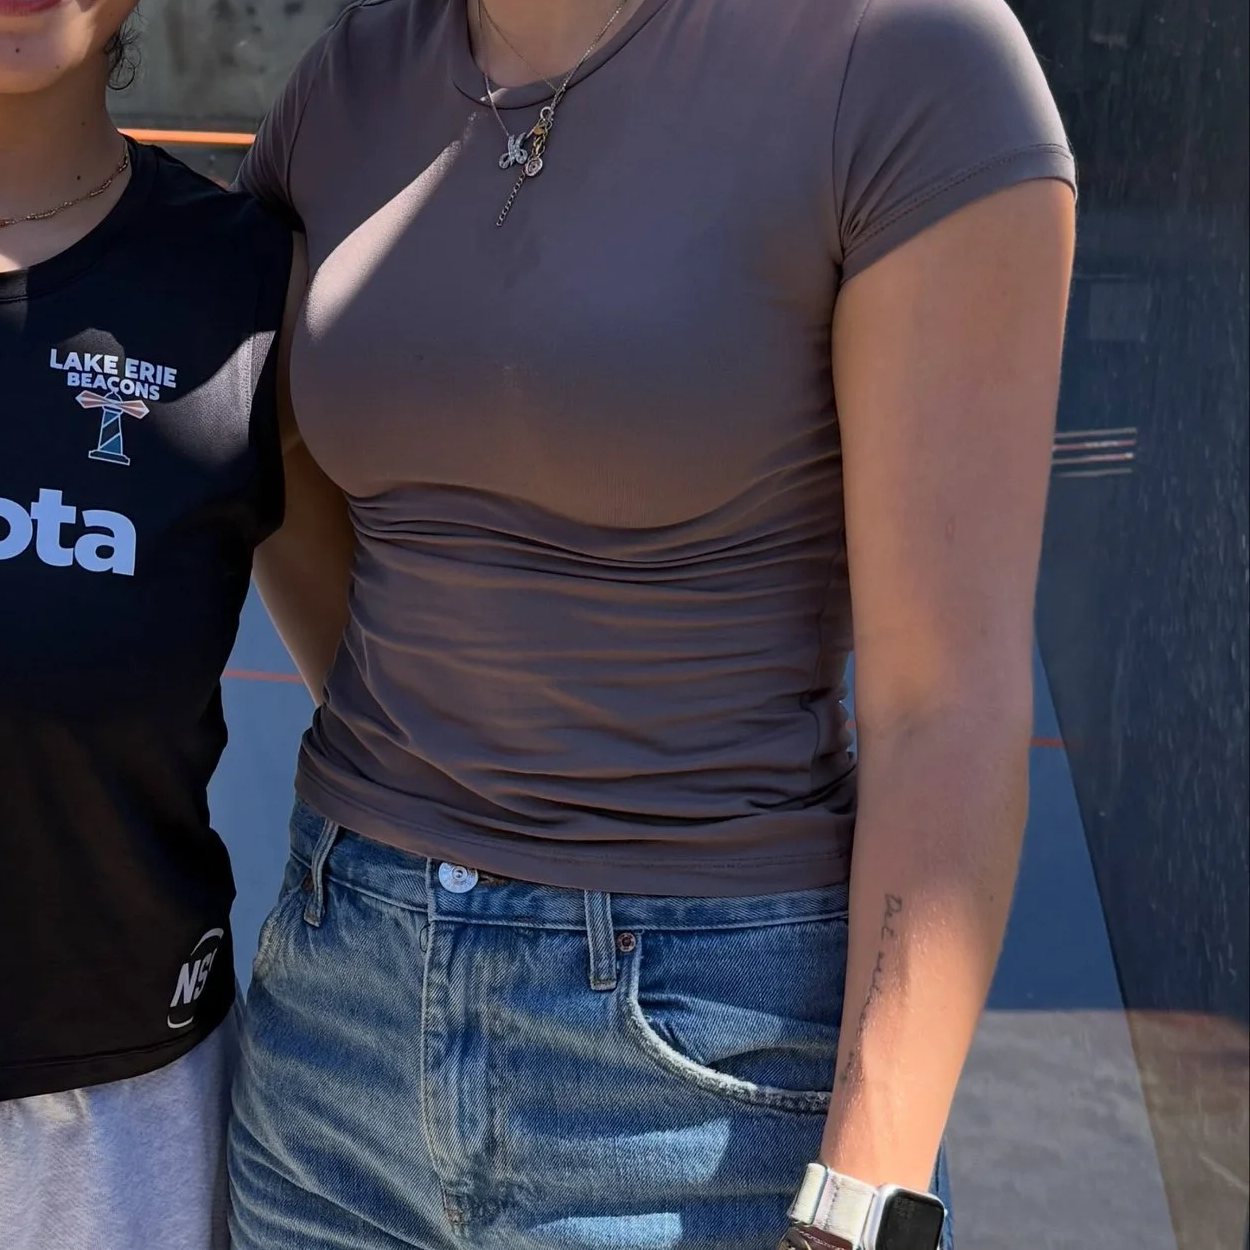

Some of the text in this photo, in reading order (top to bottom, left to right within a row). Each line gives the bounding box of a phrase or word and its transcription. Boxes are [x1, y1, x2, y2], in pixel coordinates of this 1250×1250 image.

[49, 348, 178, 388] LAKE ERIE
[67, 371, 160, 401] BEACONS
